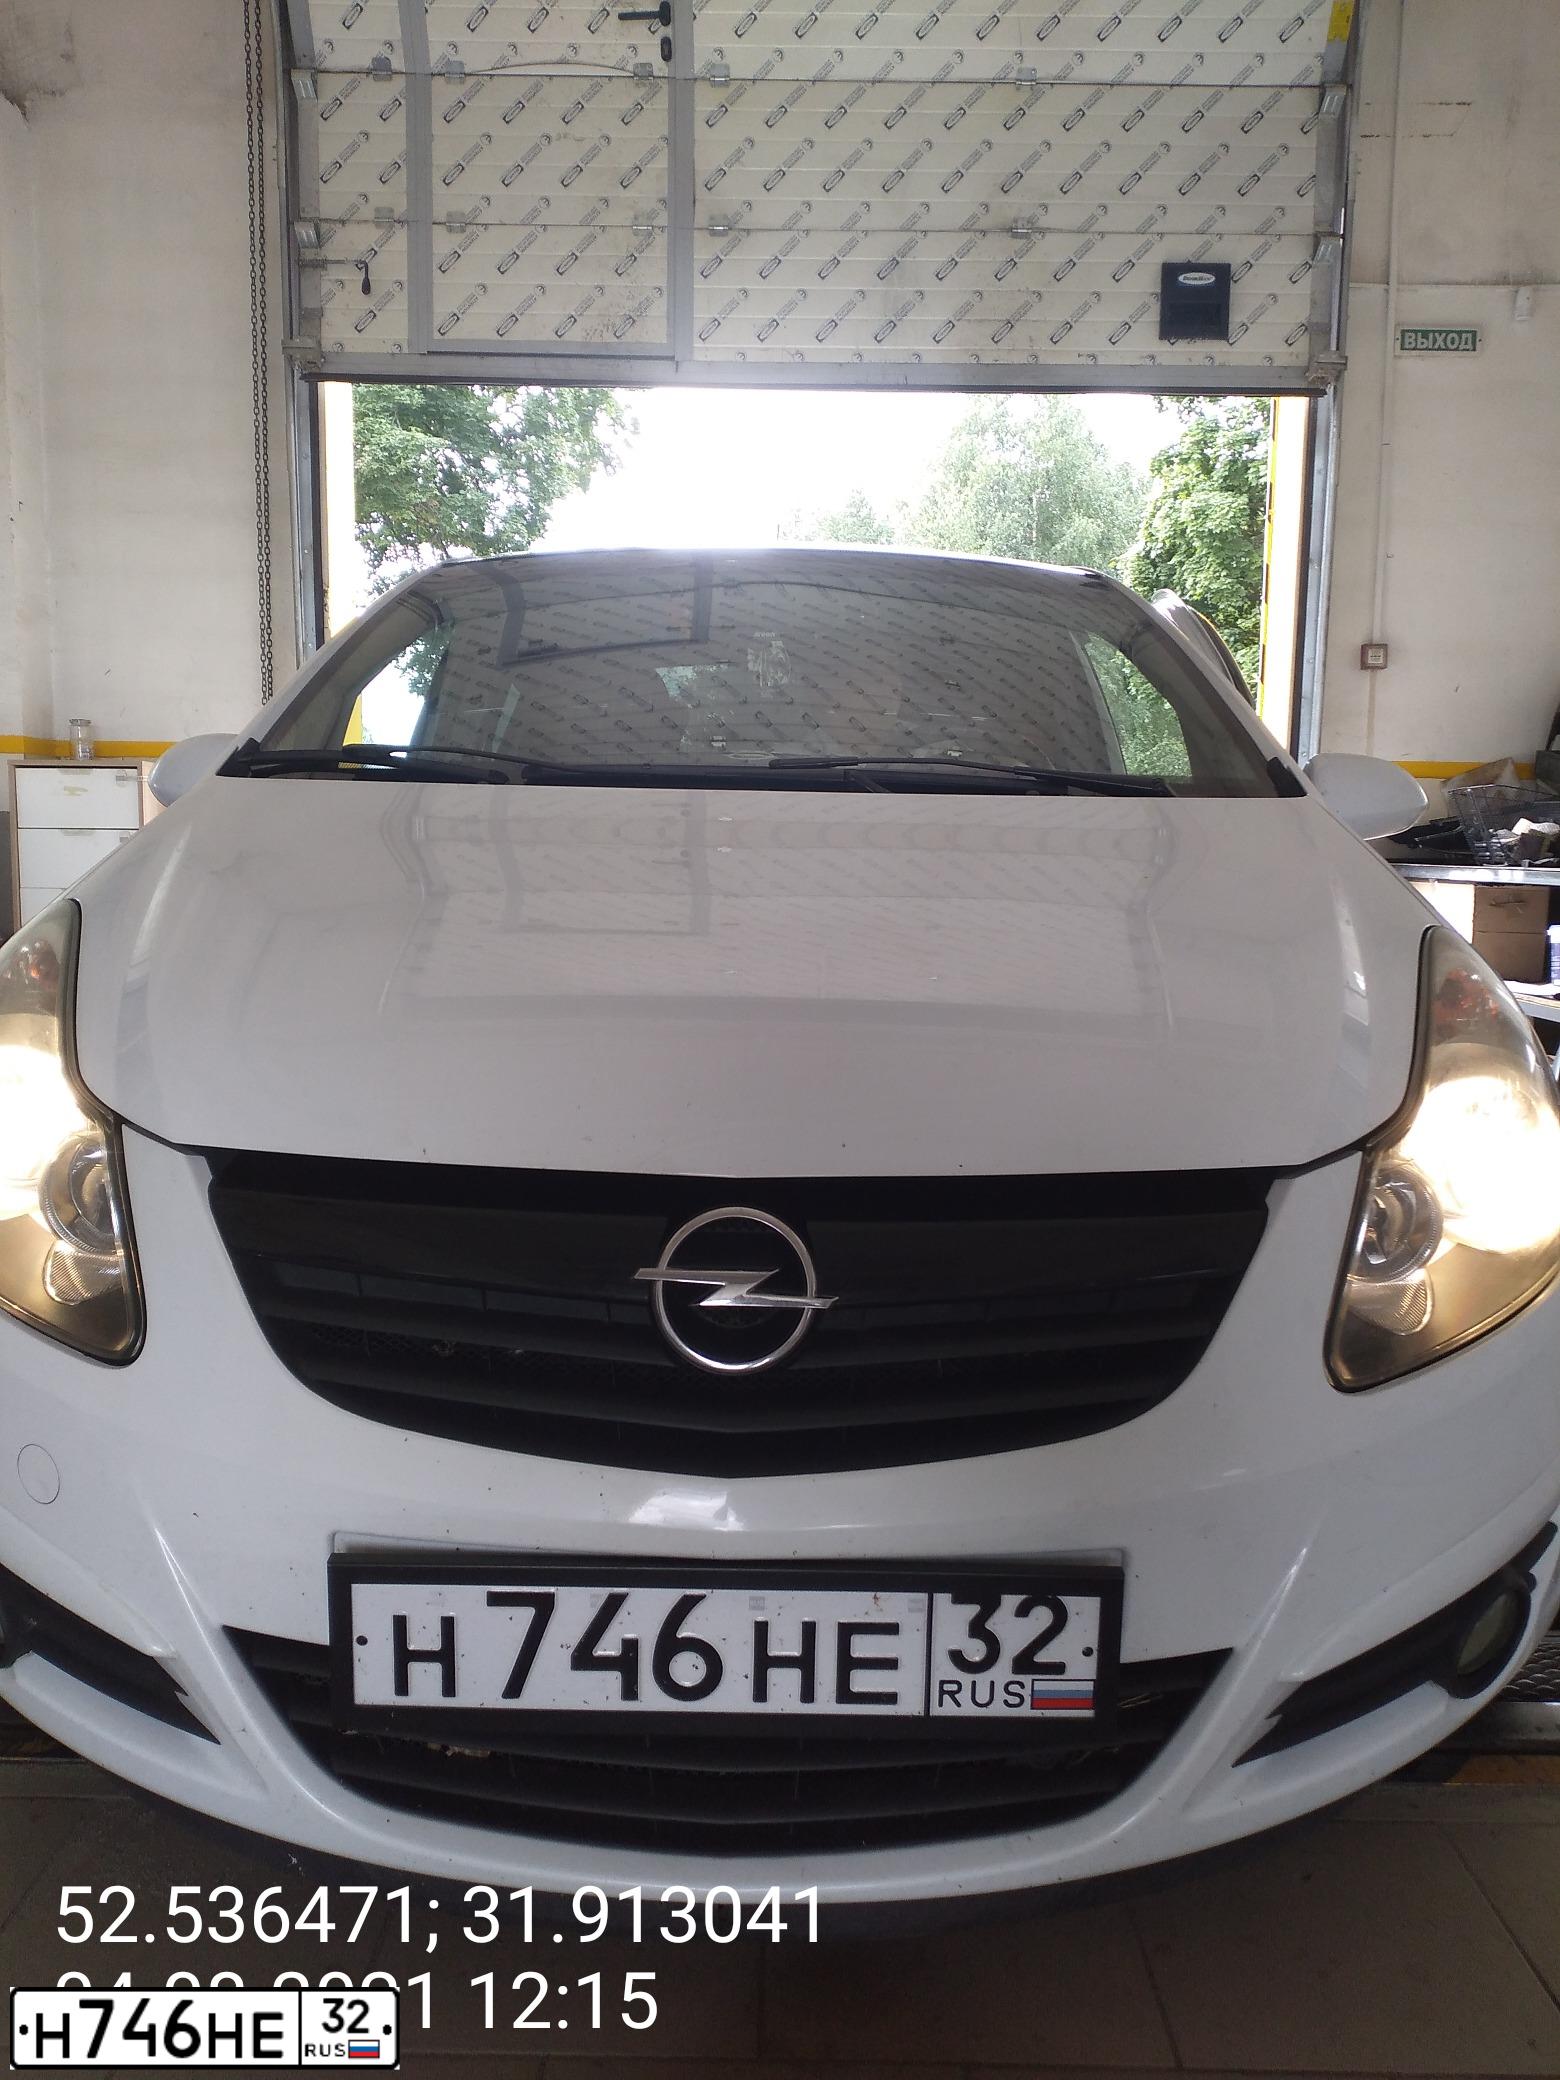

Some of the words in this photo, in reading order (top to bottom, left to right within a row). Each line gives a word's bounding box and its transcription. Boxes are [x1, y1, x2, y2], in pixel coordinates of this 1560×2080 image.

[1403, 332, 1474, 351] ВЫХОД
[947, 1593, 1067, 1677] 32
[937, 1679, 1027, 1709] RUS
